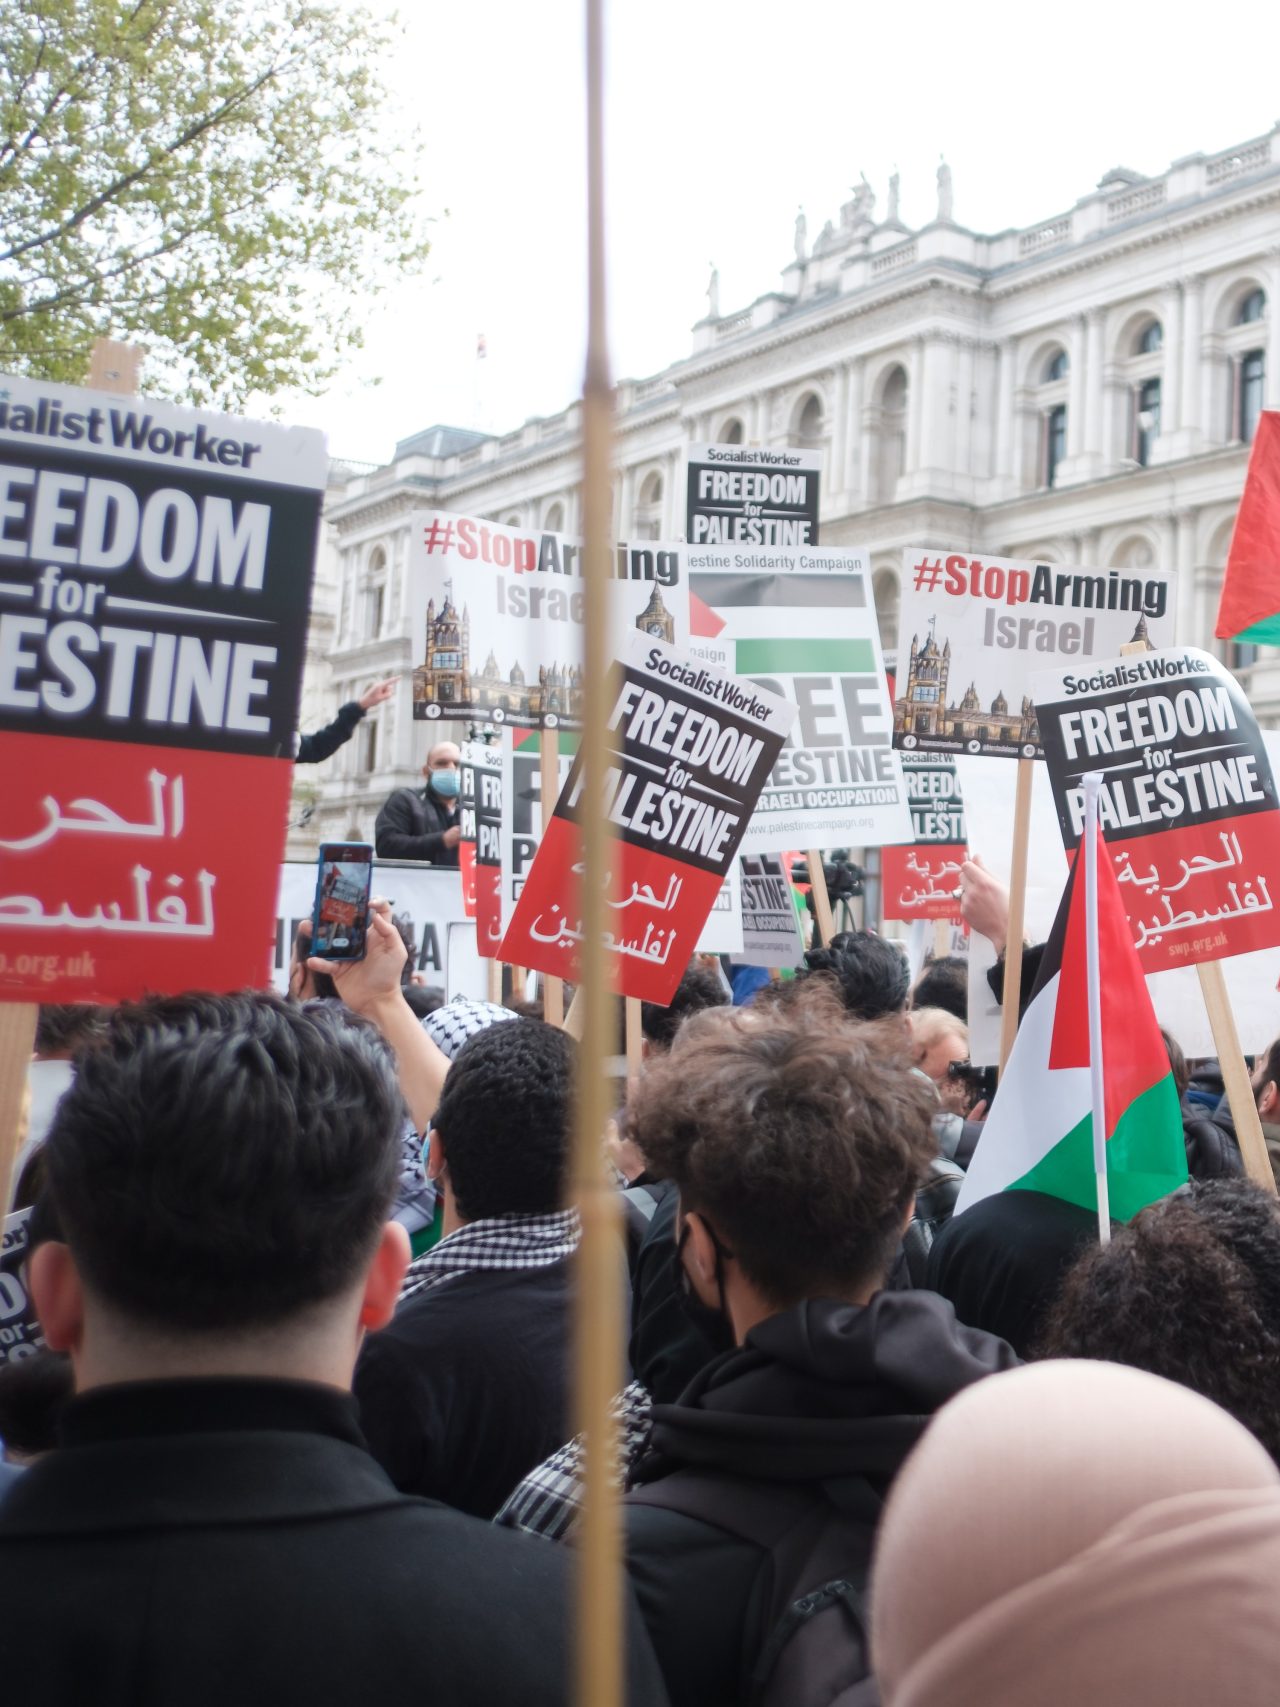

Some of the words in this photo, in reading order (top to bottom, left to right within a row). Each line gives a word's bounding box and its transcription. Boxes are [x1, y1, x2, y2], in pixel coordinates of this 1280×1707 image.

[698, 469, 807, 505] FREEDOM
[743, 501, 762, 516] for
[692, 514, 812, 546] PALESTINE
[735, 555, 796, 571] Solidarity
[800, 556, 862, 571] Campaign
[39, 566, 105, 615] for
[497, 575, 587, 625] Israe
[913, 554, 1168, 619] #StopArming
[983, 607, 1096, 656] Israel
[0, 613, 277, 733] ESTINE
[606, 680, 765, 786] FREEDOM
[1058, 686, 1239, 760] FREEDOM
[664, 760, 692, 790] for
[1143, 747, 1172, 770] for
[807, 787, 898, 809] OCCUPATION
[932, 798, 948, 811] for
[1115, 831, 1243, 895] الحرية
[1168, 931, 1229, 957] swp.org.uk
